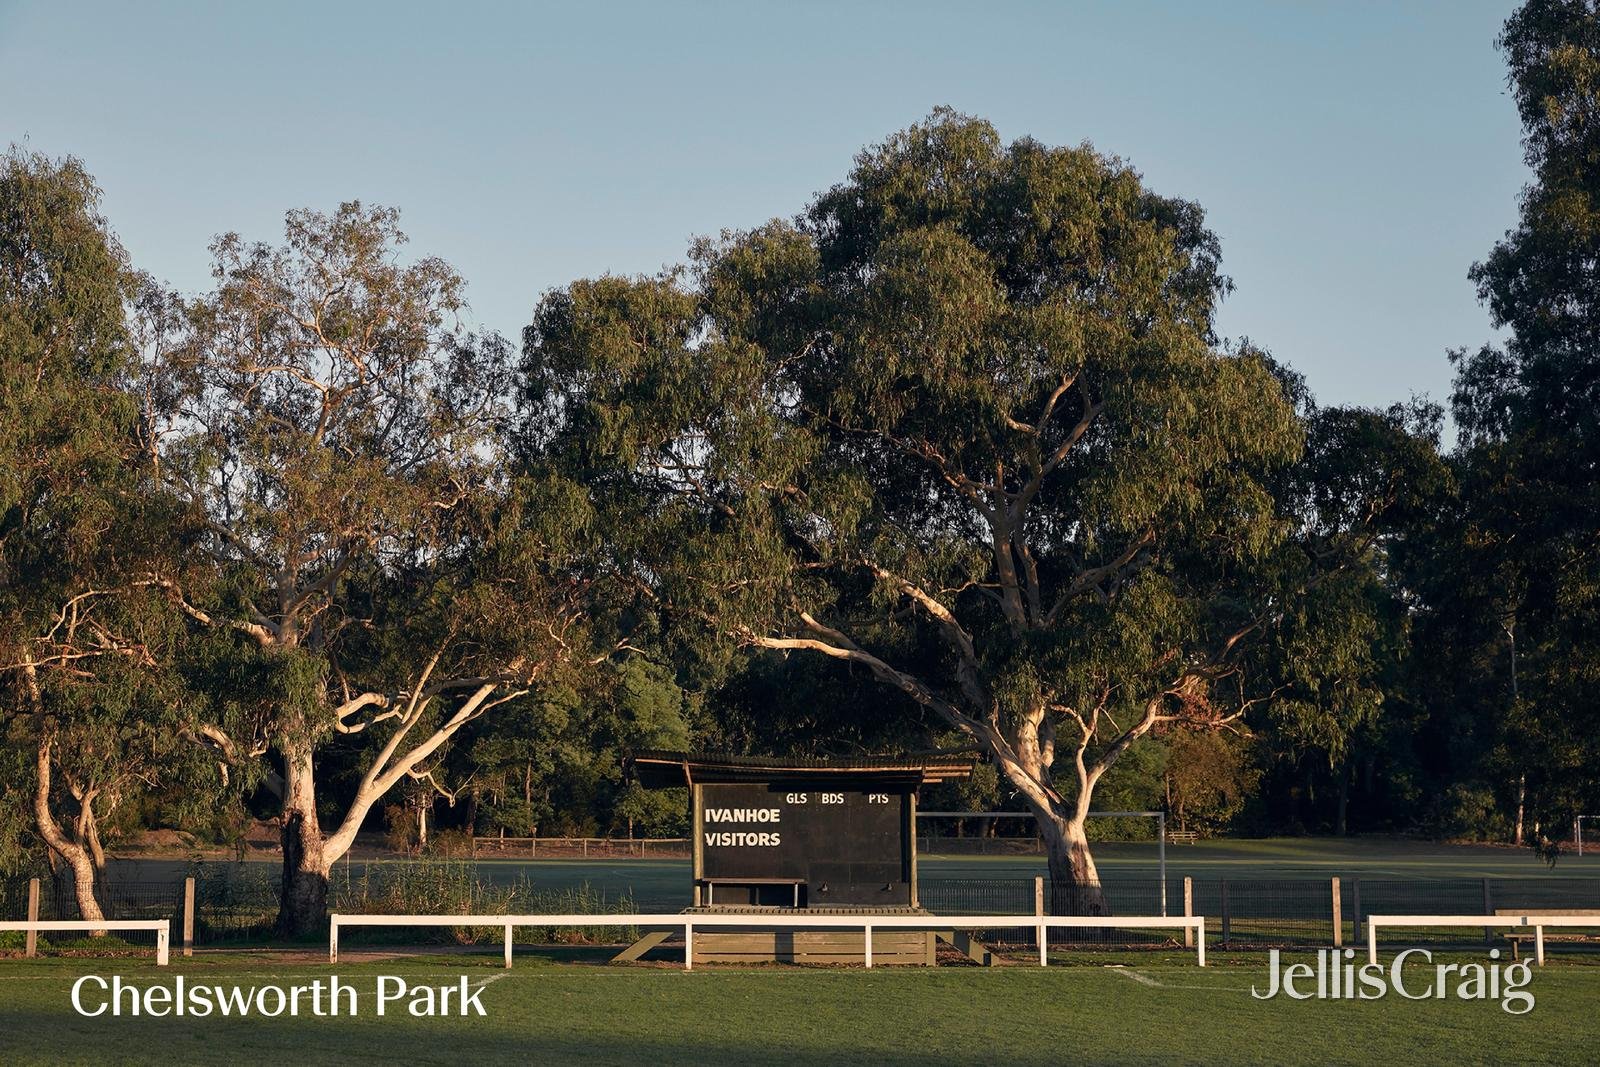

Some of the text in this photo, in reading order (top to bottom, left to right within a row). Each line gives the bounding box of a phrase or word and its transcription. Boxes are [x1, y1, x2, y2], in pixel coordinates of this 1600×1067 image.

[786, 793, 889, 804] GLS BDS PTS
[705, 808, 780, 823] IVANHOE
[705, 832, 780, 847] VISITORS
